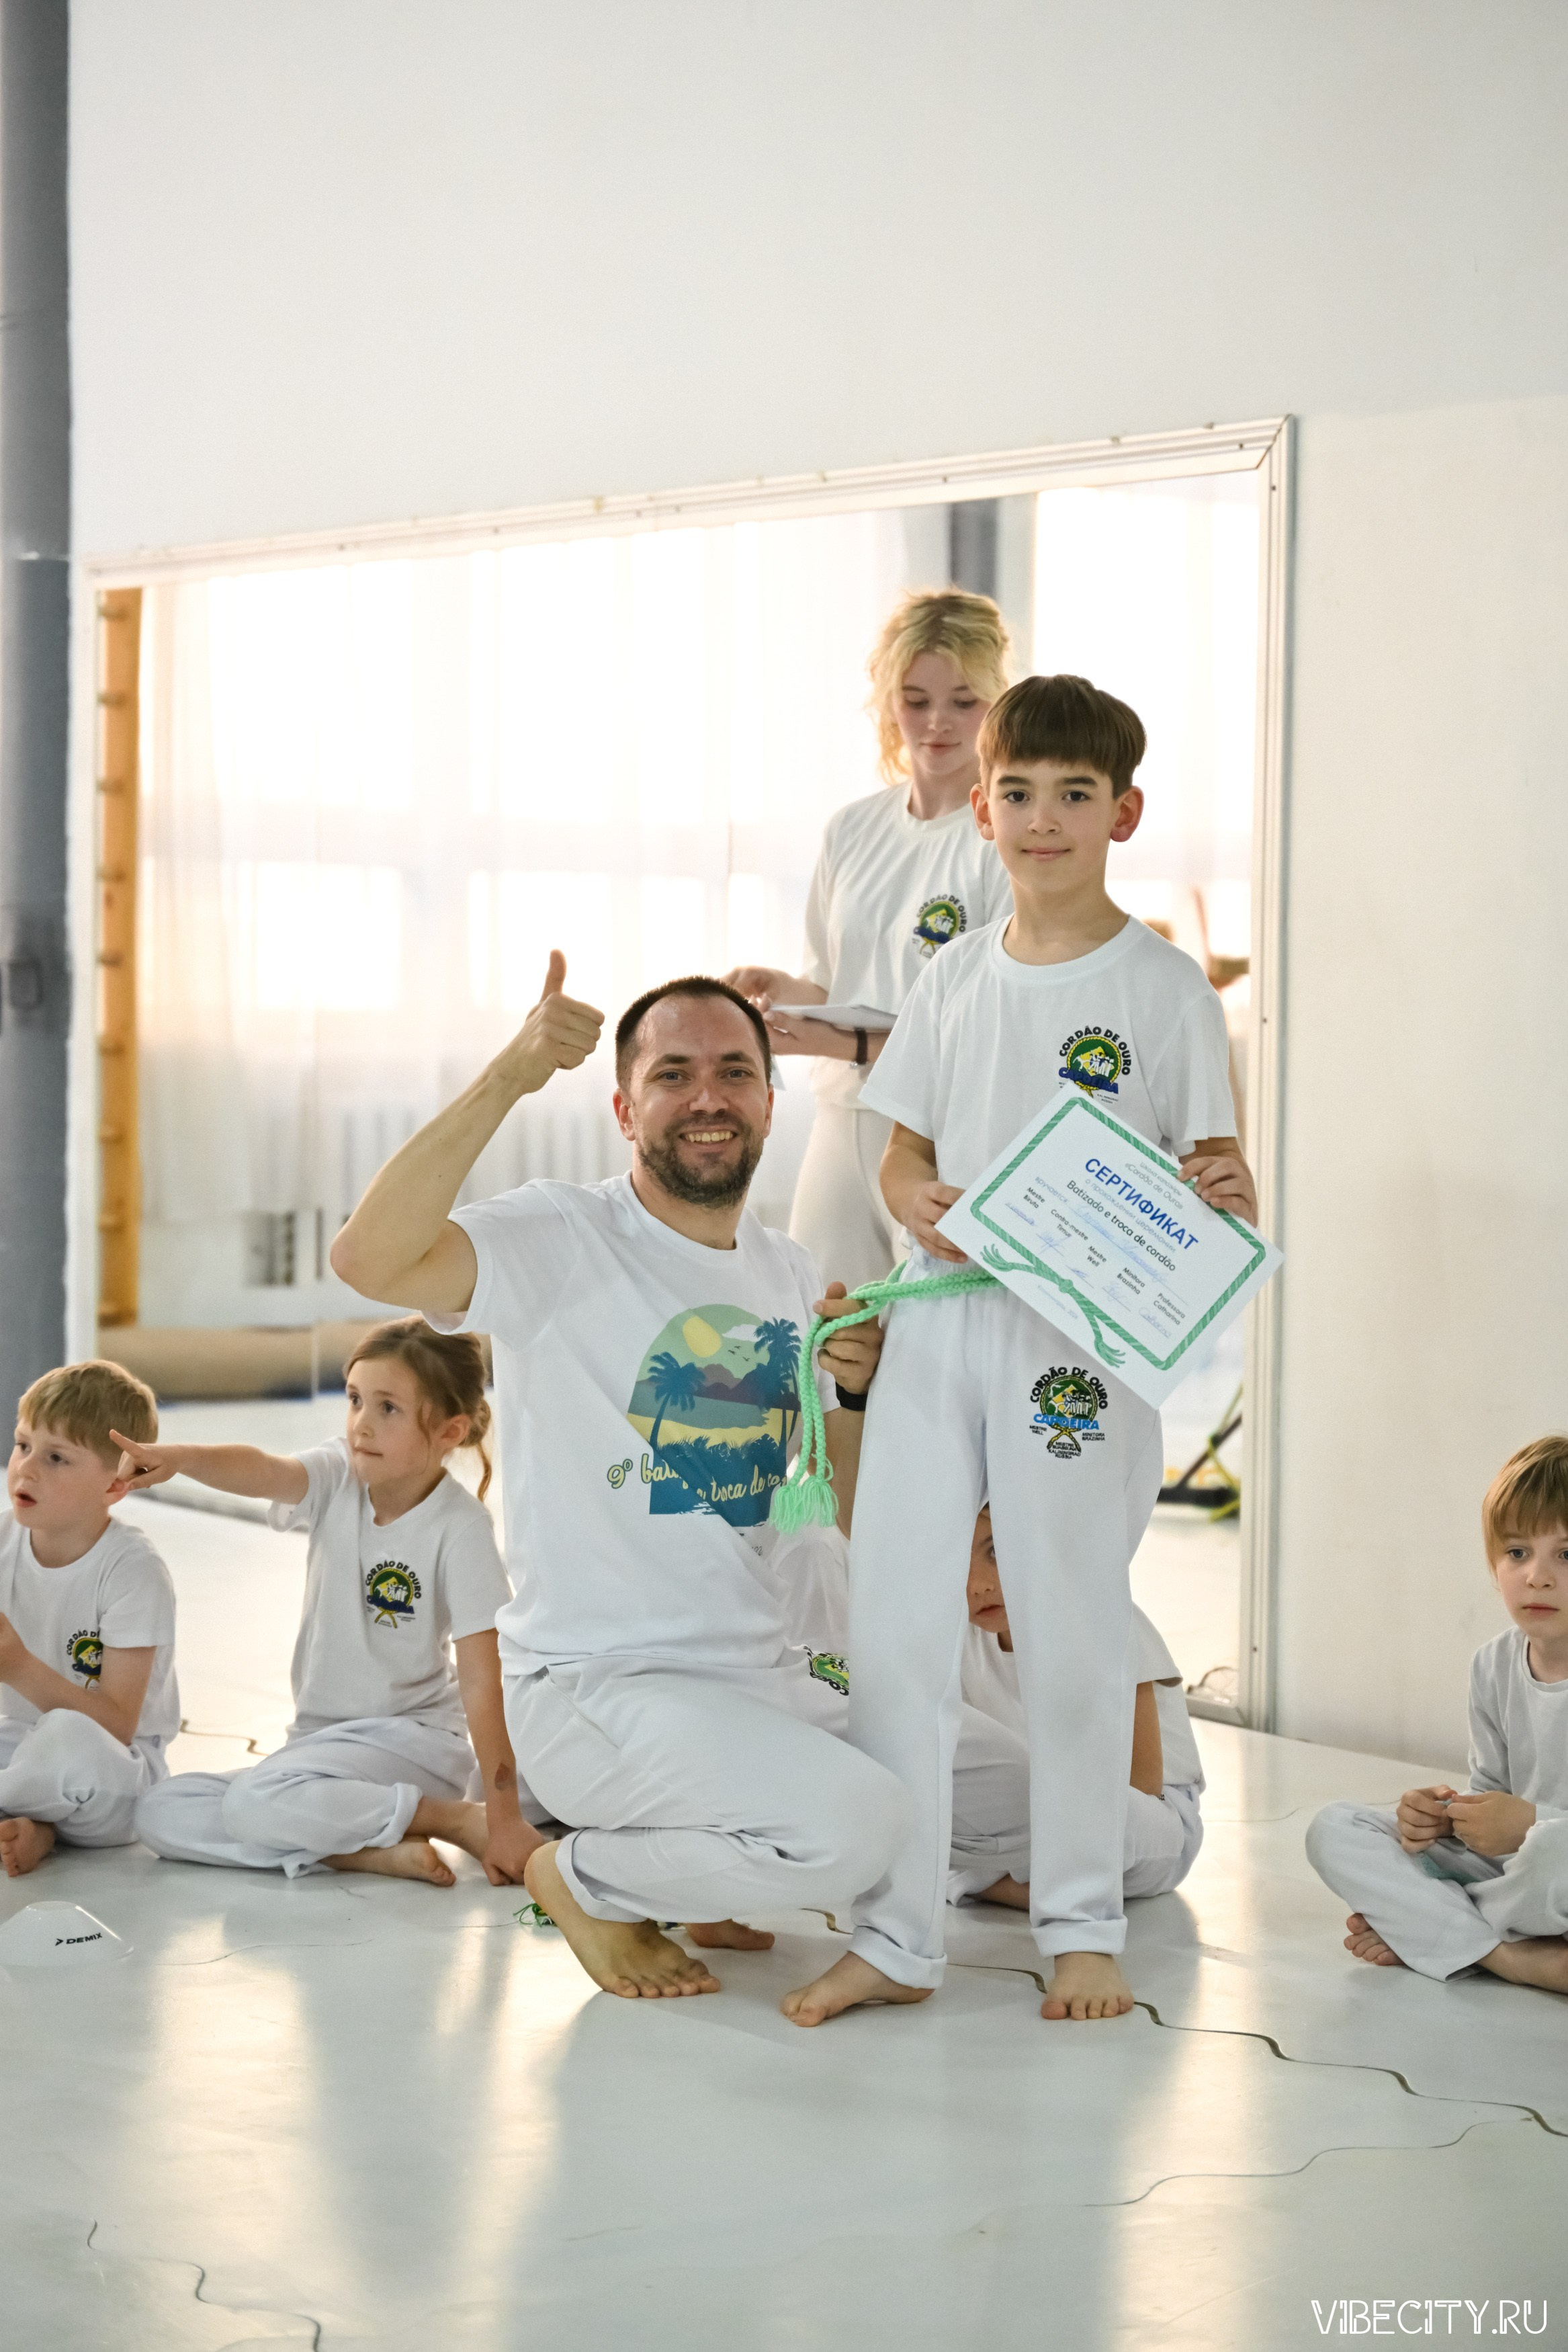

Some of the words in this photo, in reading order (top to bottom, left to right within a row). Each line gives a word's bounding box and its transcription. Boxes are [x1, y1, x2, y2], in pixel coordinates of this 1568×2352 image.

[949, 895, 960, 905] DE
[958, 905, 967, 932] OURO
[1059, 1025, 1102, 1056] CORDÃO
[1104, 1029, 1120, 1042] DE
[1119, 1042, 1131, 1075] OURO
[1022, 1193, 1039, 1208] Biruta
[1027, 1186, 1045, 1203] Mestre
[1152, 1183, 1163, 1193] de
[1085, 1158, 1198, 1249] СЕРТИФИКАТ
[1050, 1208, 1088, 1241] Contra-mestre
[1066, 1179, 1104, 1212] Batizado
[1103, 1210, 1111, 1218] e
[1110, 1214, 1133, 1236] troca
[1133, 1234, 1145, 1247] de
[1145, 1245, 1176, 1271] cordão
[1086, 1255, 1100, 1267] Well
[1088, 1245, 1106, 1262] Mestre
[1116, 1272, 1141, 1294] Brazinha
[1122, 1267, 1145, 1288] Minitora
[1153, 1300, 1180, 1325] Catharina
[1157, 1292, 1185, 1318] Professora
[1030, 1366, 1068, 1402] CORDÃO
[1072, 1367, 1088, 1378] DE
[1090, 1377, 1108, 1409] OURO
[1033, 1413, 1099, 1430] CAPOEIRA
[365, 1560, 395, 1586] CORDÃO
[396, 1562, 409, 1572] DE
[408, 1571, 421, 1599] OURO
[67, 1629, 88, 1656] CORDÃO
[67, 1933, 102, 1944] DEMIX
